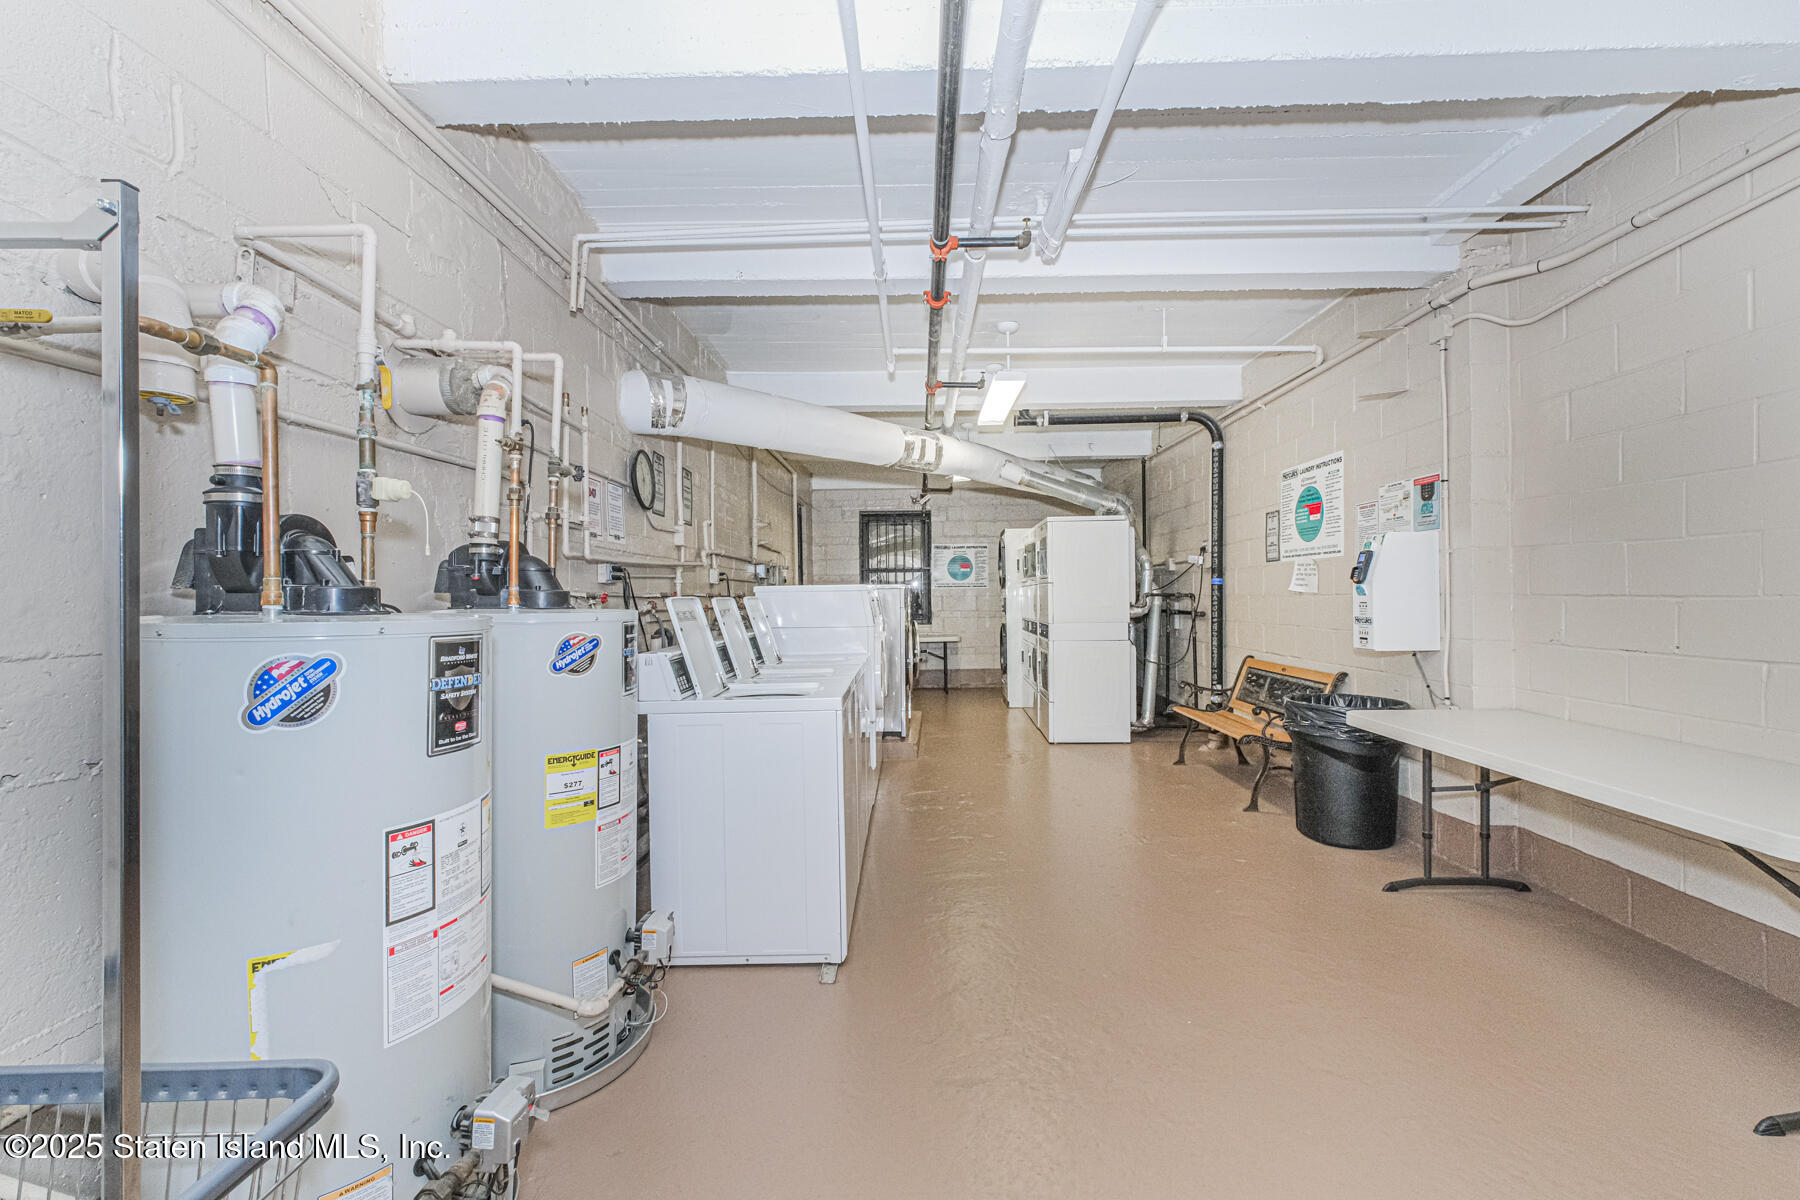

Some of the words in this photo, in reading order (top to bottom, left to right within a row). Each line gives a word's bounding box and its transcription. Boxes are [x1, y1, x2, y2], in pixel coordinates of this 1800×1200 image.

[1316, 456, 1343, 470] INSTRUCTIONS
[556, 646, 586, 670] Hydrojet
[431, 673, 482, 691] DEFENDER
[252, 675, 308, 721] Hydrojet
[440, 691, 460, 700] SAFETY
[460, 688, 477, 697] SYSTEM
[404, 827, 428, 838] DANGER
[344, 1176, 376, 1194] WARNING
